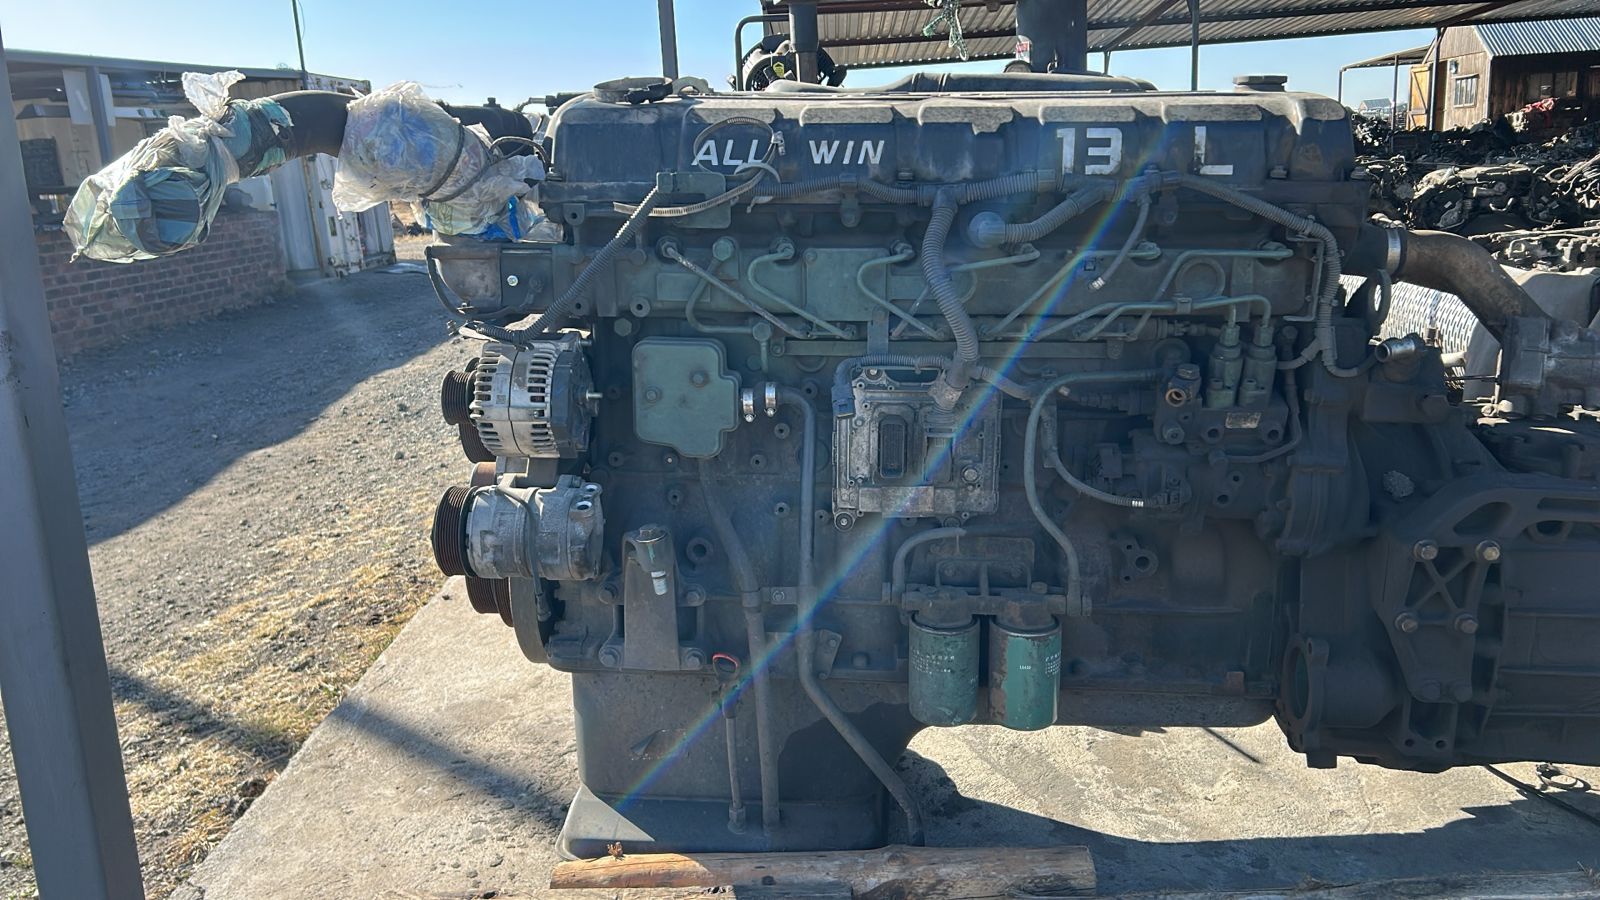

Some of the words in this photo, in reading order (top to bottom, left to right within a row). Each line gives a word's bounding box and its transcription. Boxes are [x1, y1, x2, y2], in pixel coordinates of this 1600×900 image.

[691, 139, 763, 166] ALL
[808, 140, 885, 165] WIN
[1056, 127, 1123, 176] 13
[1194, 126, 1234, 175] L
